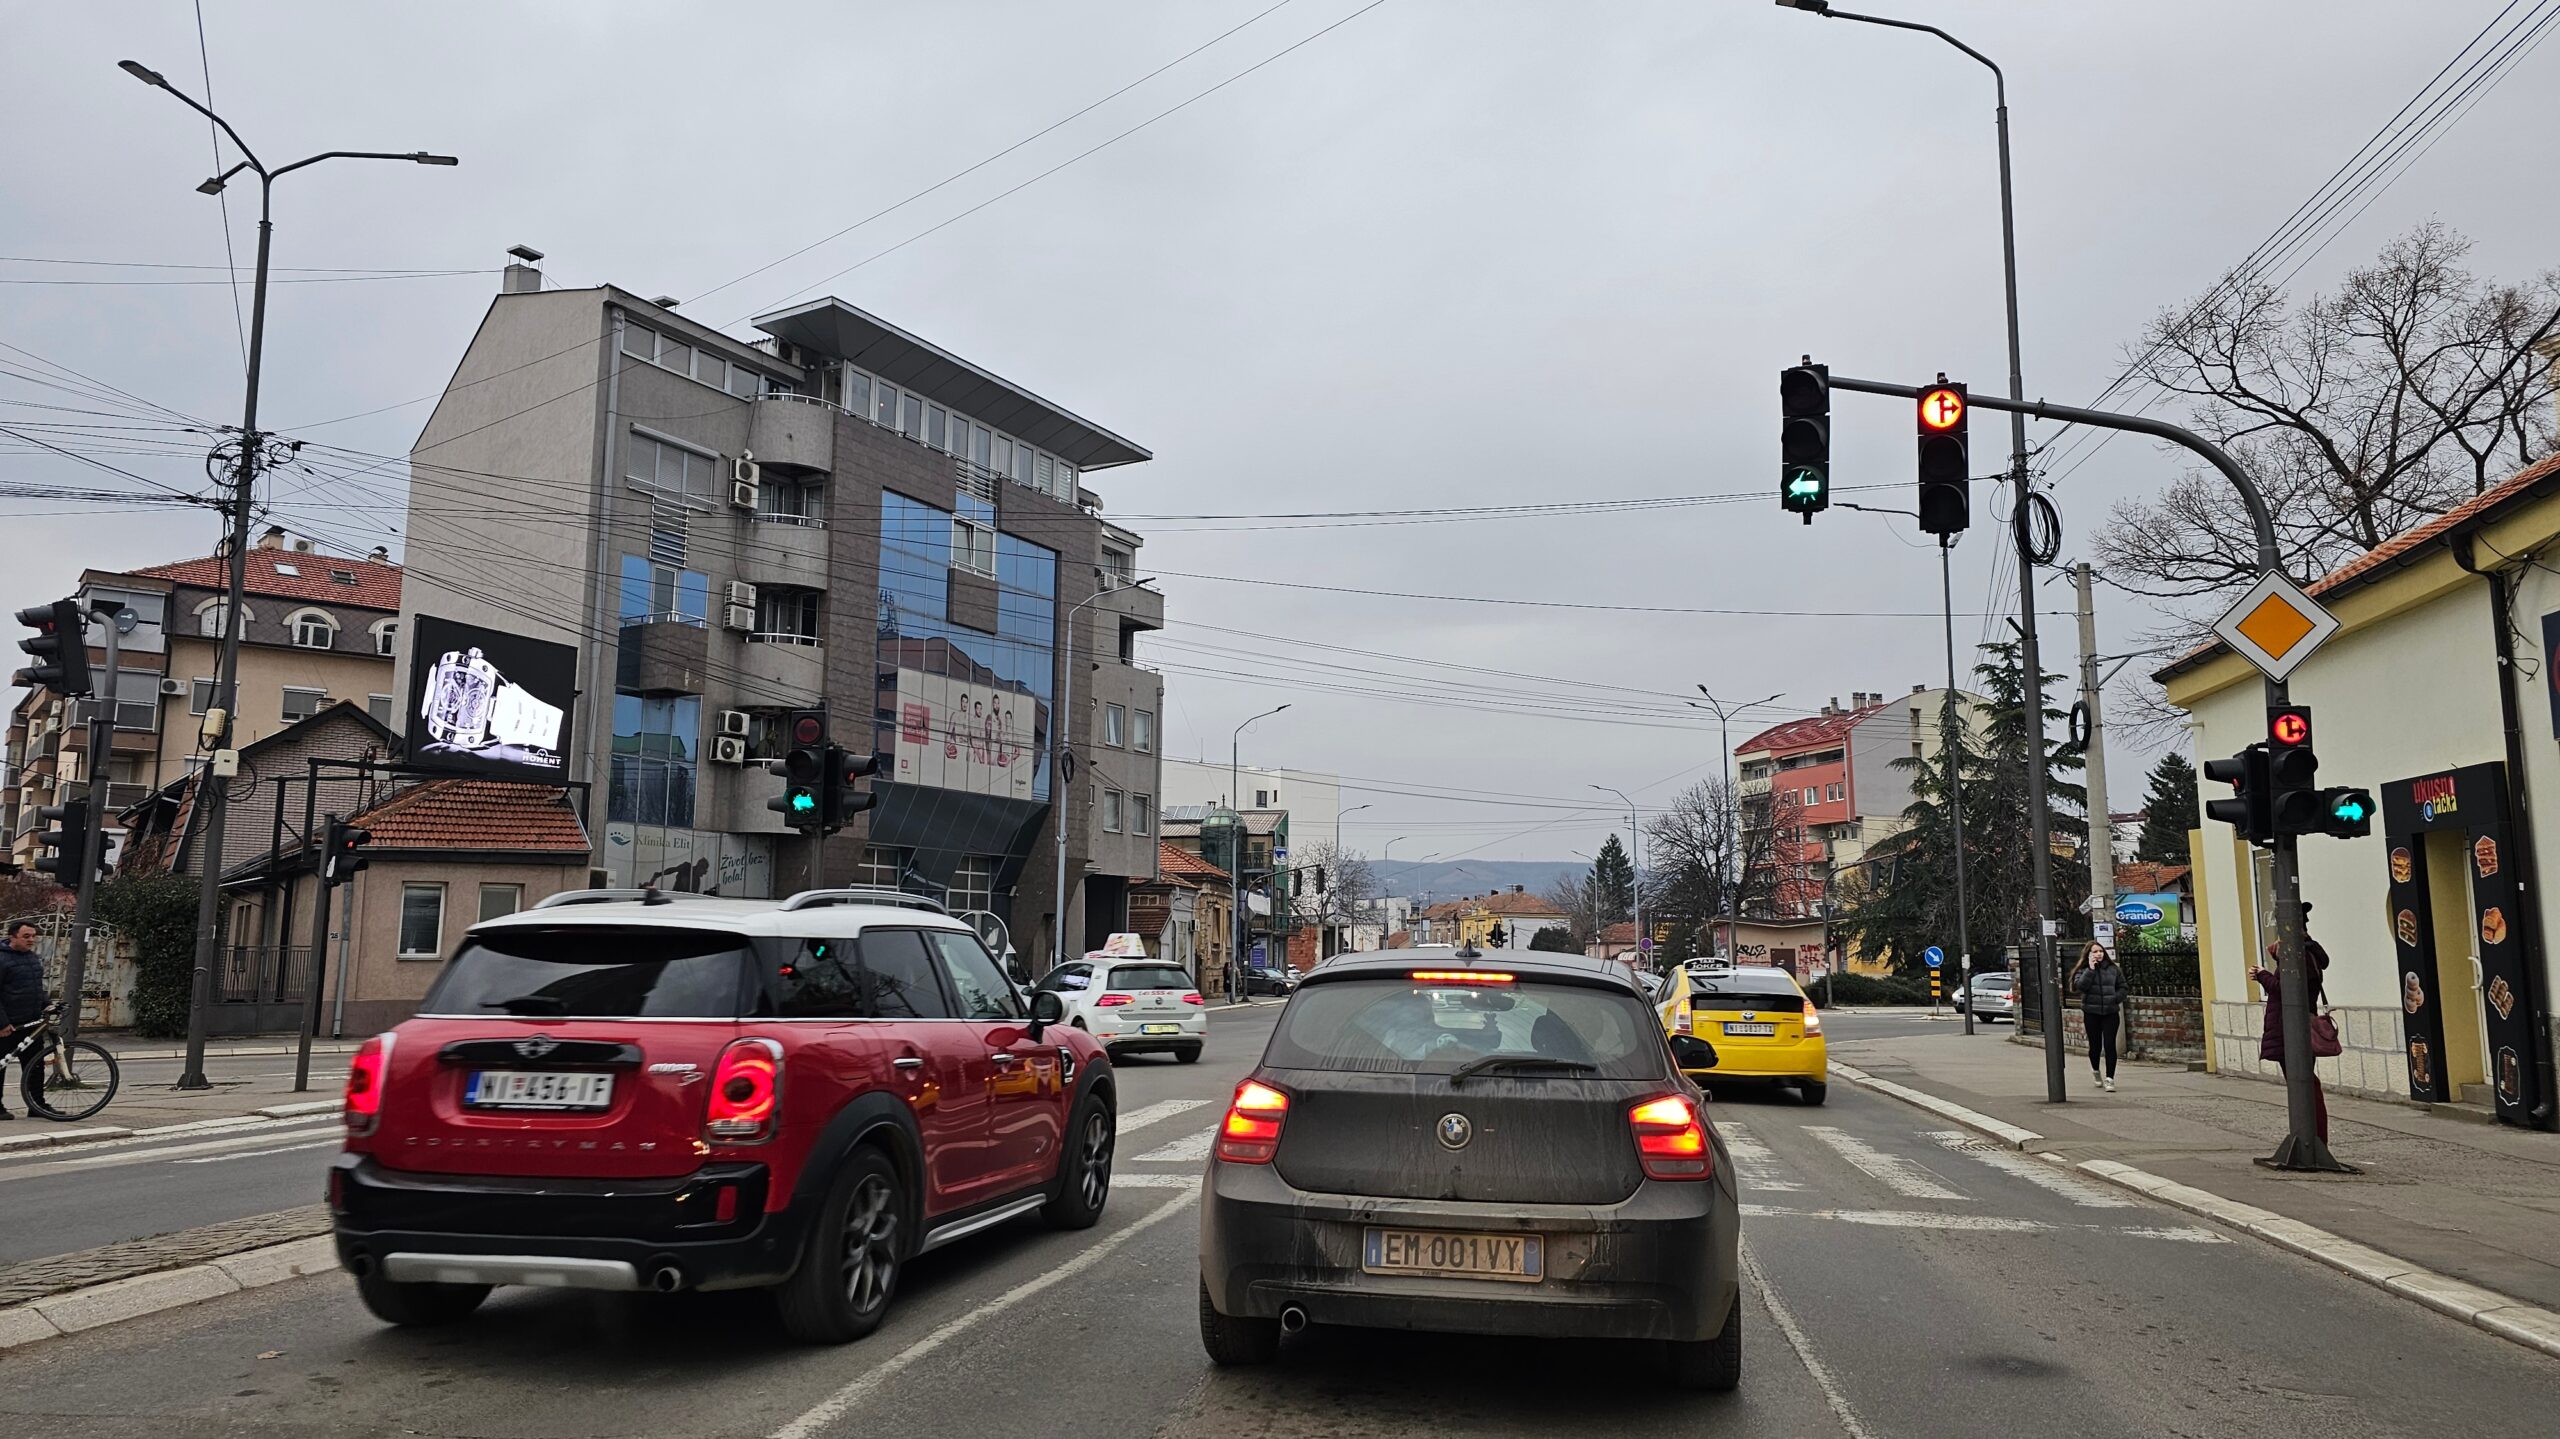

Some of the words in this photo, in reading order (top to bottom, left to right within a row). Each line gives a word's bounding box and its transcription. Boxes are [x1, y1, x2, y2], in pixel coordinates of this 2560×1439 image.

[637, 834, 671, 848] Klinika
[673, 837, 690, 849] Elit
[2115, 910, 2161, 920] Granice
[1385, 1234, 1420, 1266] EM
